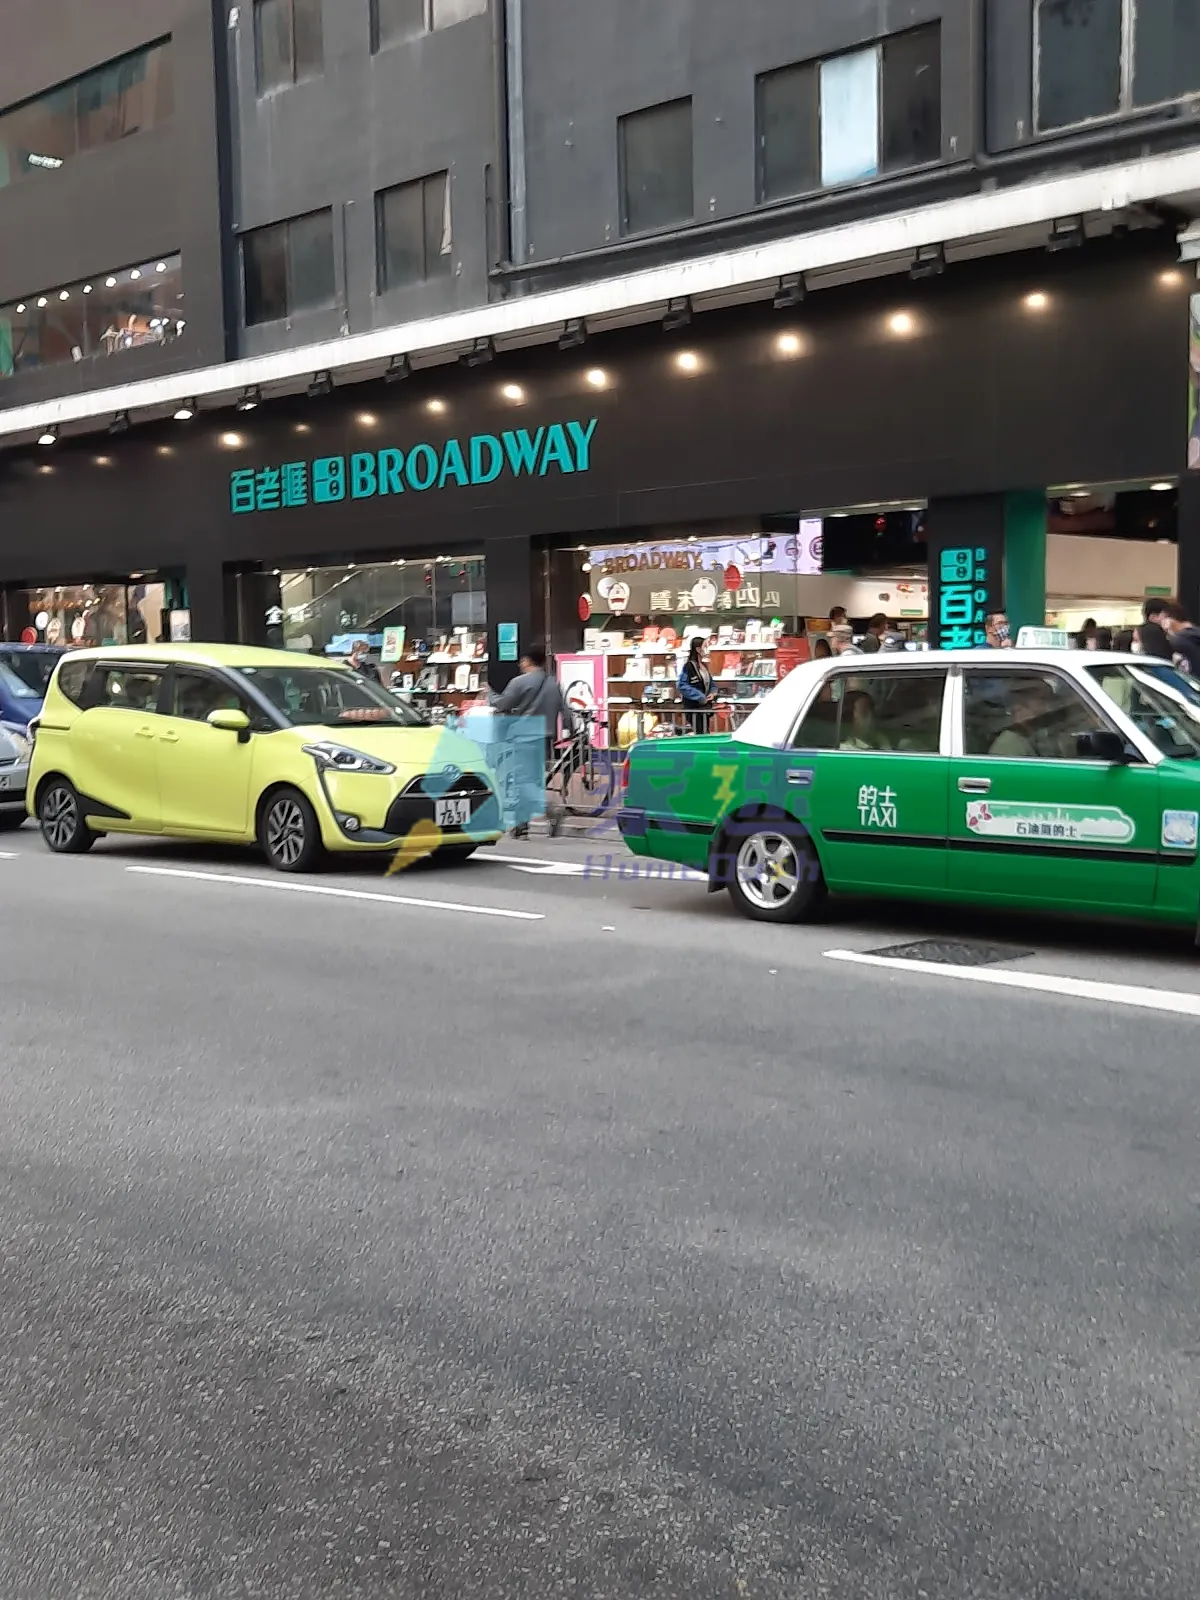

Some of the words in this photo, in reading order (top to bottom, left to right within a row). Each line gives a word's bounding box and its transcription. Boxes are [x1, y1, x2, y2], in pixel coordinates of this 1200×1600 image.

[351, 418, 598, 499] BROADWAY
[858, 784, 898, 807] 的士
[440, 809, 467, 825] 7631
[857, 805, 897, 828] TAXI
